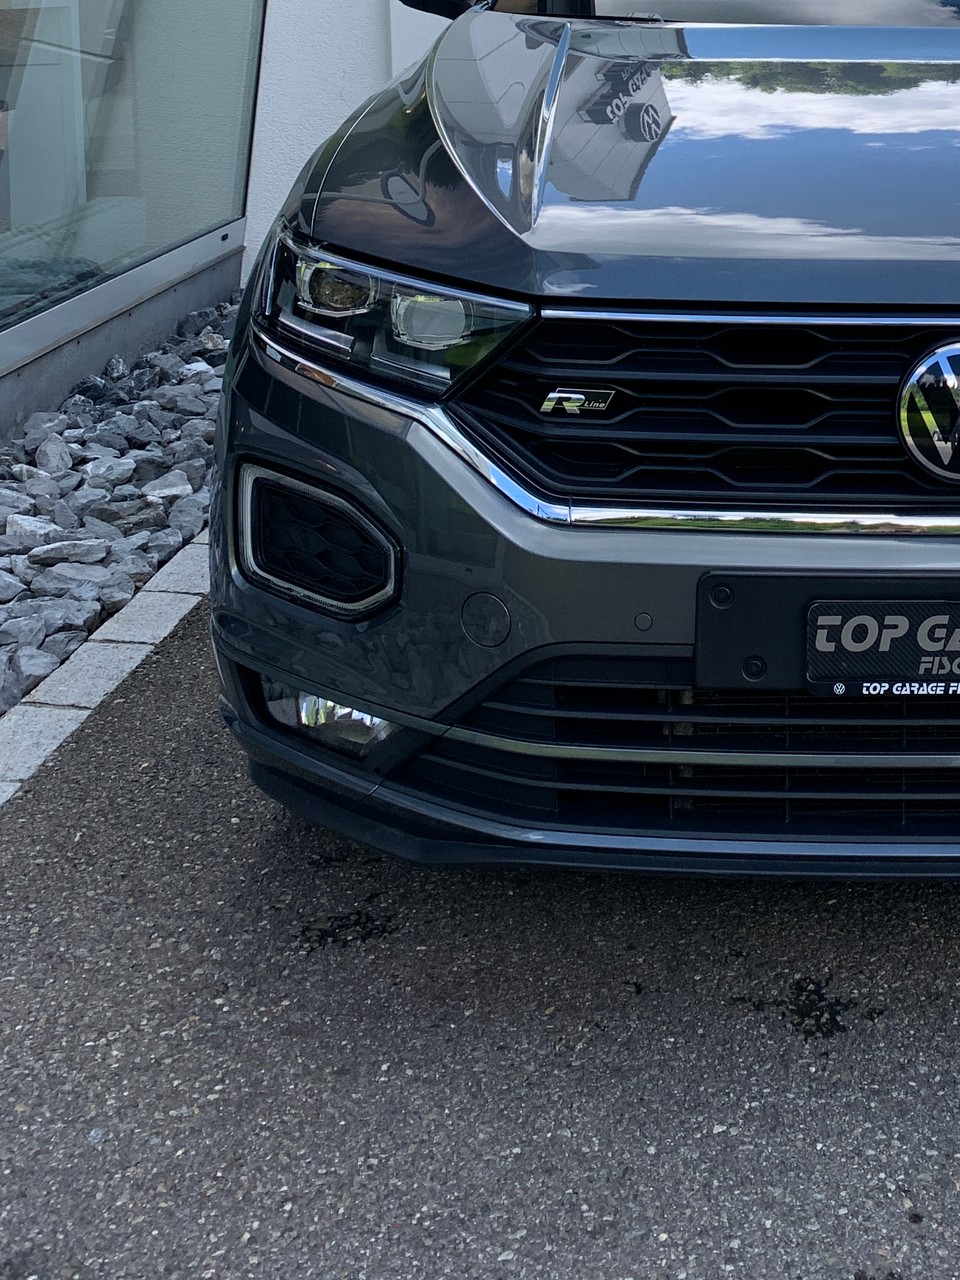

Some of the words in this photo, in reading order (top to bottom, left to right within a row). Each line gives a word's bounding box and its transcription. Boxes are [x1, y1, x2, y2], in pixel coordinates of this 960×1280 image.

[815, 616, 909, 652] TOP
[862, 682, 890, 695] TOP
[892, 682, 945, 695] GARAGE
